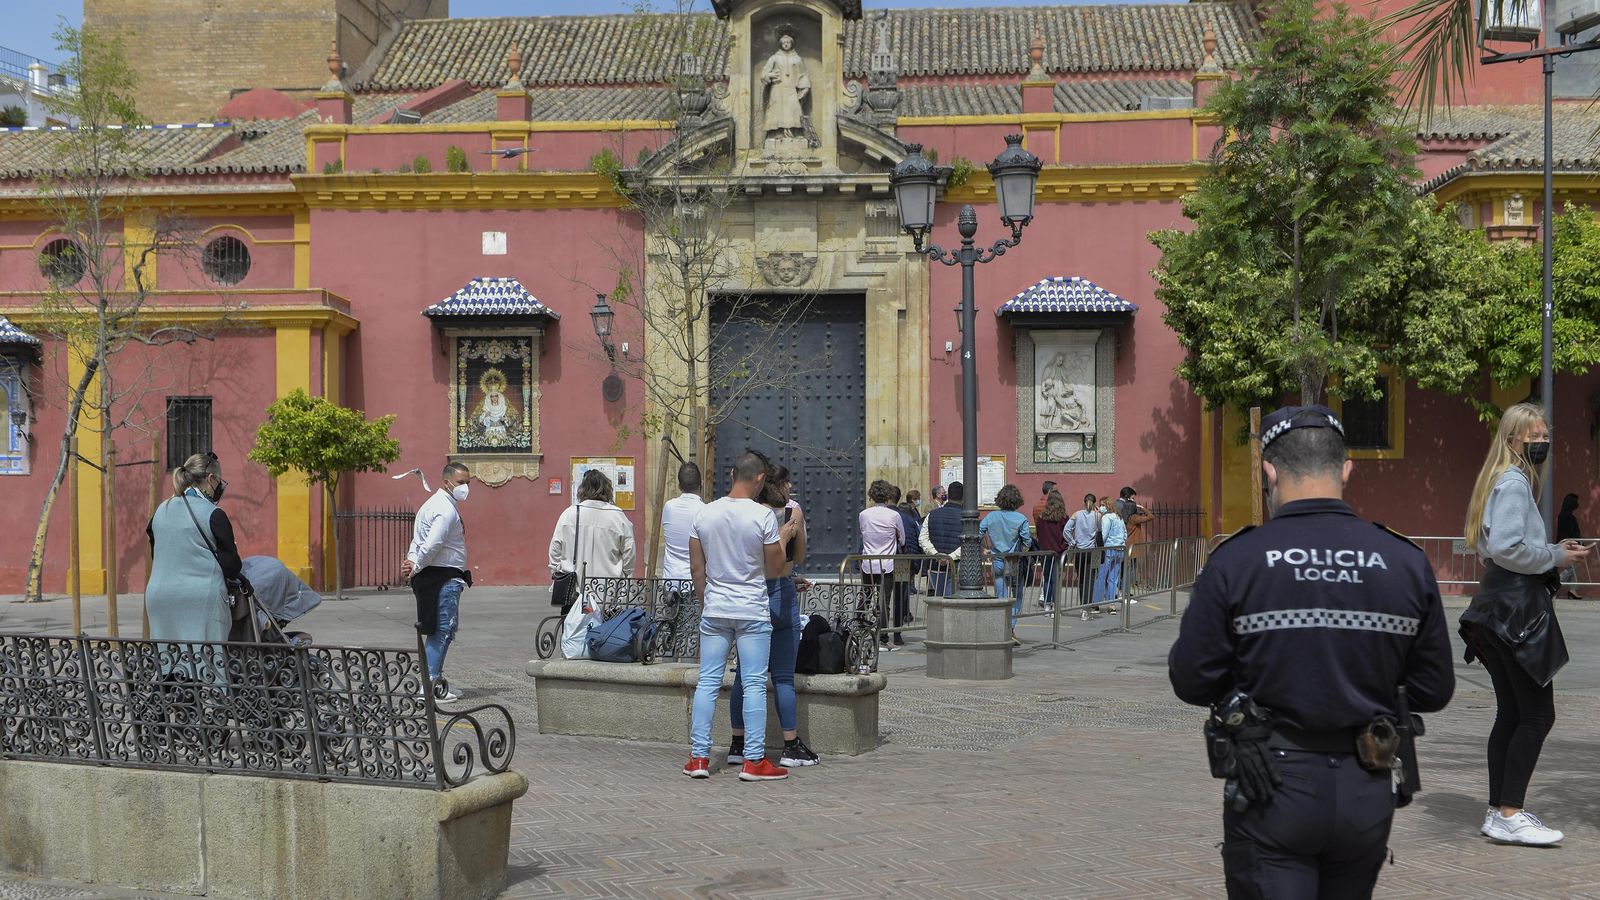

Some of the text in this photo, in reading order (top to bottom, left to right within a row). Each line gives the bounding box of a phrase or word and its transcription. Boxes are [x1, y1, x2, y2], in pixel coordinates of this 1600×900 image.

[964, 350, 971, 359] 4
[1265, 548, 1388, 570] POLICIA
[1294, 567, 1364, 583] LOCAL
